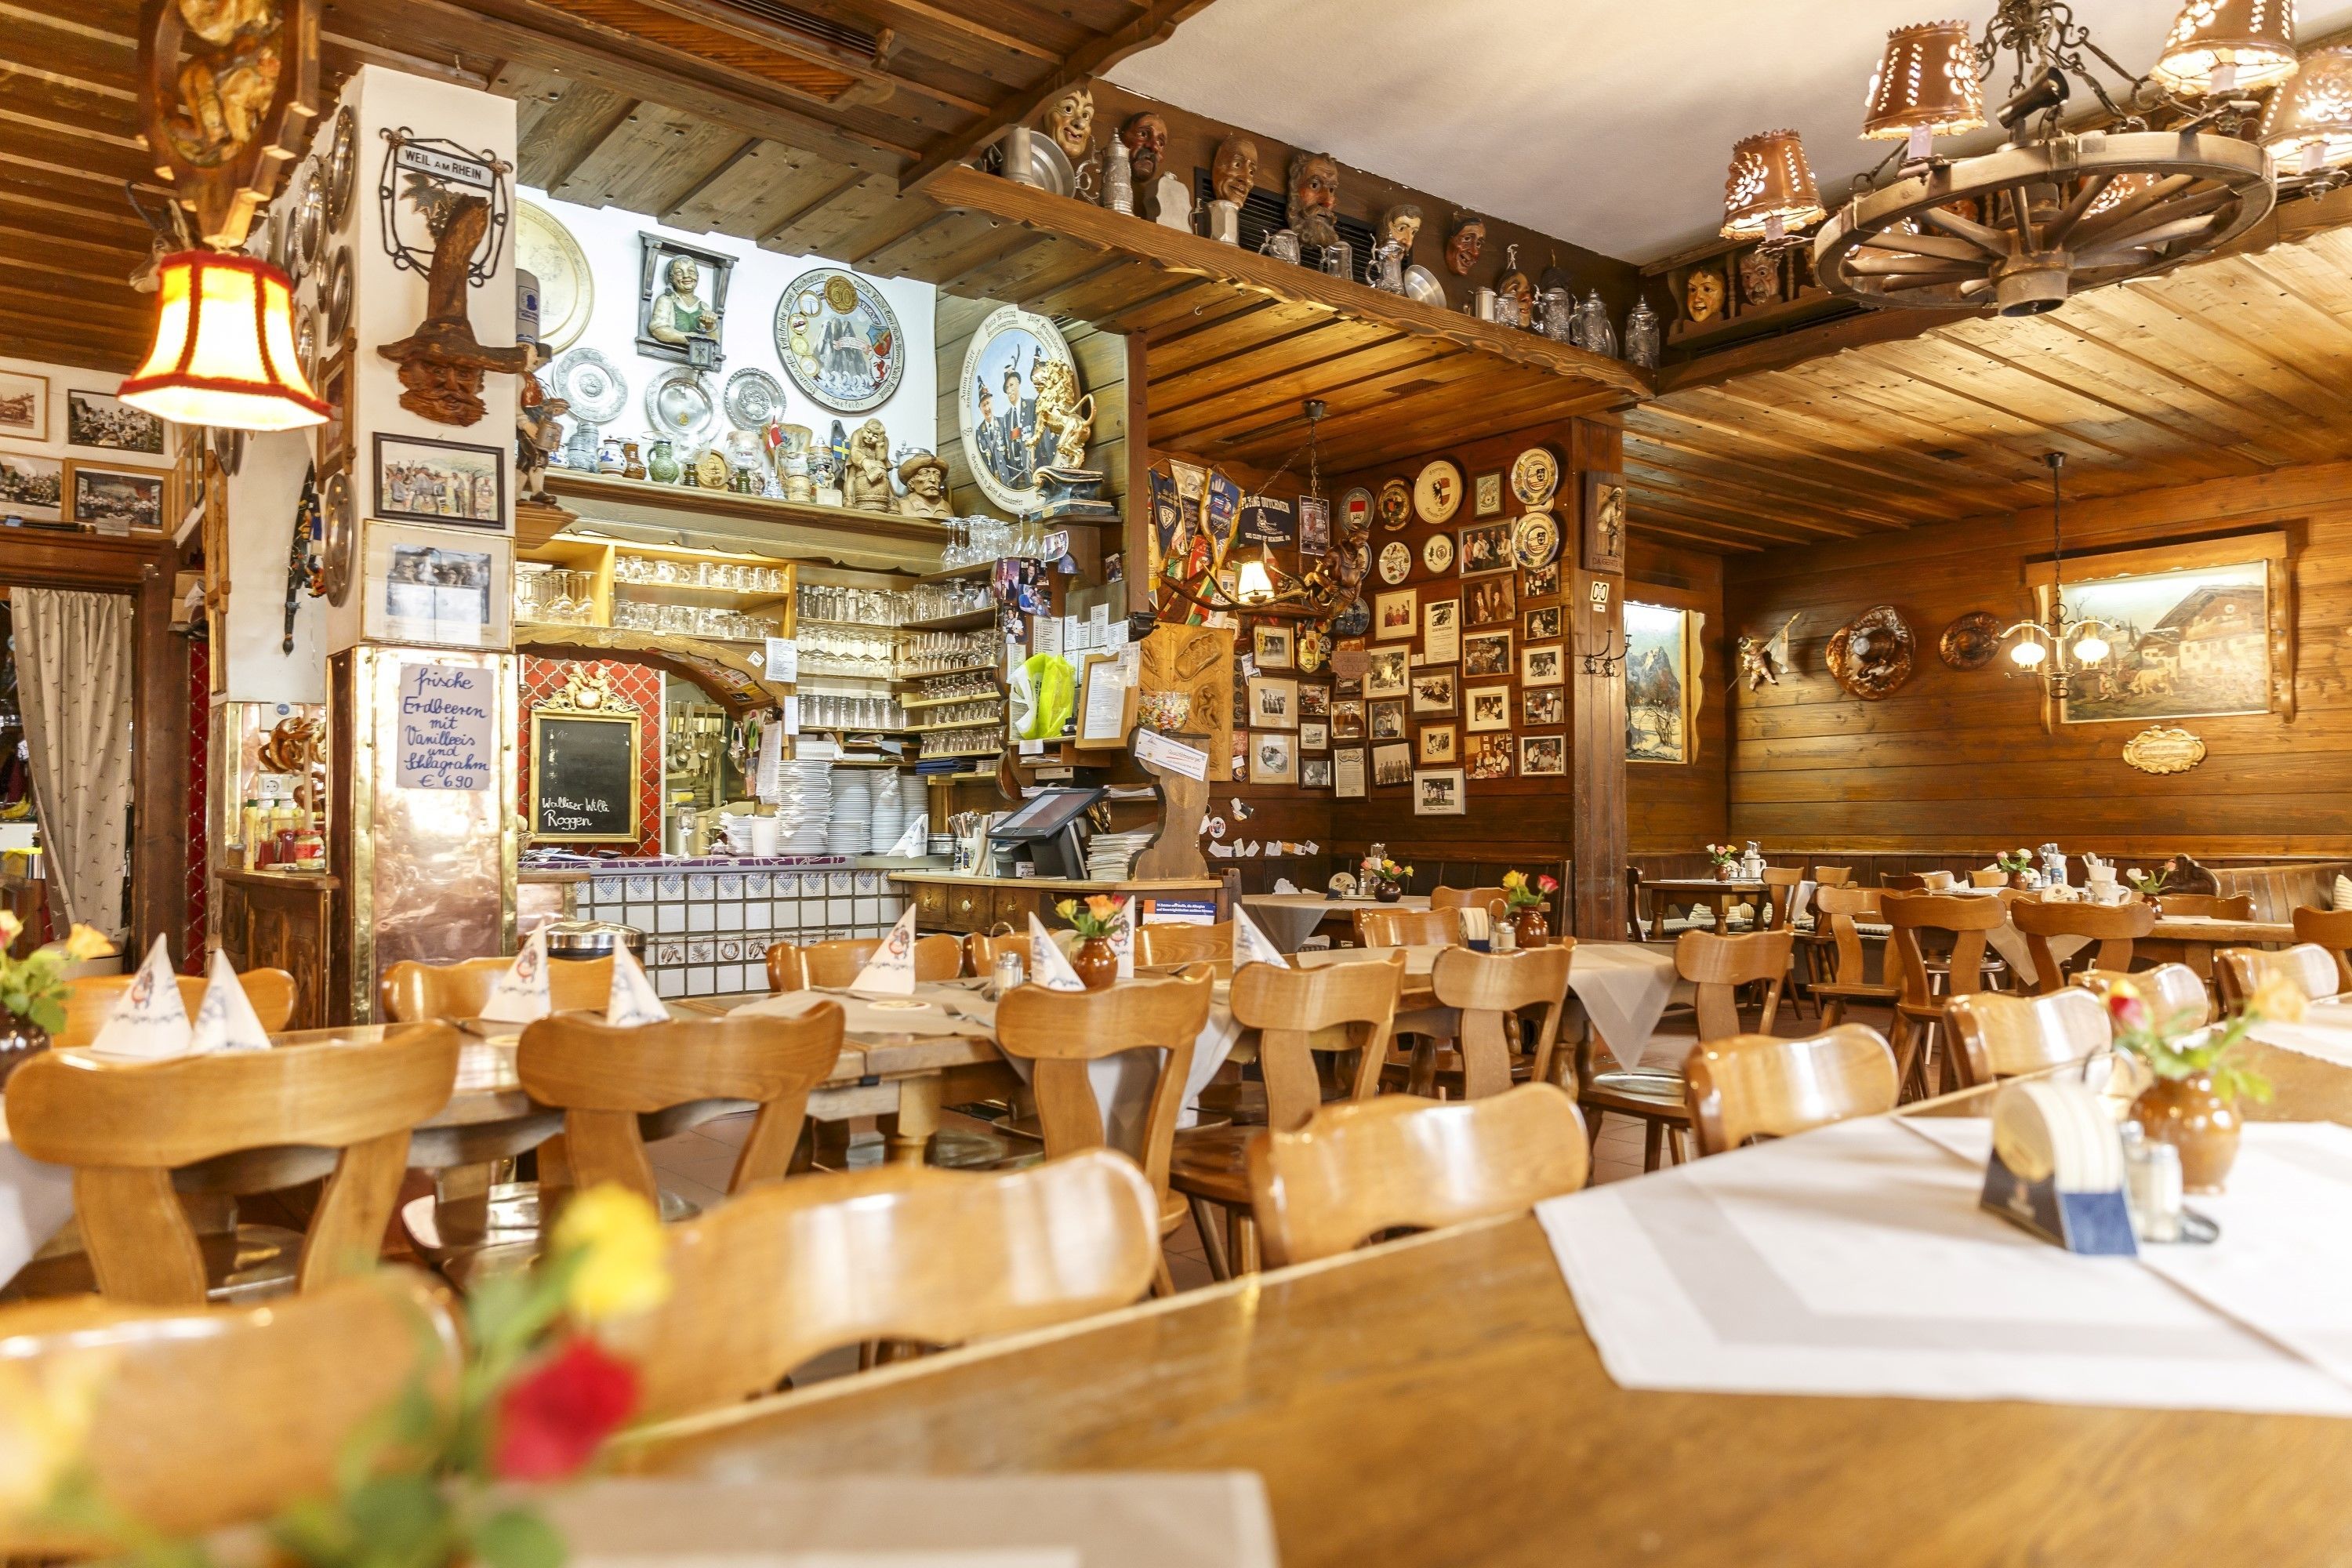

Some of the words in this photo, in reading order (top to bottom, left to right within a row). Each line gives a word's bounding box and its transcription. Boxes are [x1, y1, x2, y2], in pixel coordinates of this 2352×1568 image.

[405, 150, 430, 165] WEIL
[434, 162, 450, 172] AM
[452, 162, 481, 180] RHEIN
[960, 377, 969, 402] Anton
[830, 400, 861, 409] Seefeld
[414, 668, 474, 695] frische
[404, 696, 488, 718] Erdbeeren
[430, 717, 458, 730] mit
[405, 724, 476, 746] Vanilleeis
[427, 746, 459, 757] und
[404, 753, 489, 778] Schlagrahm
[543, 809, 593, 830] Roggen
